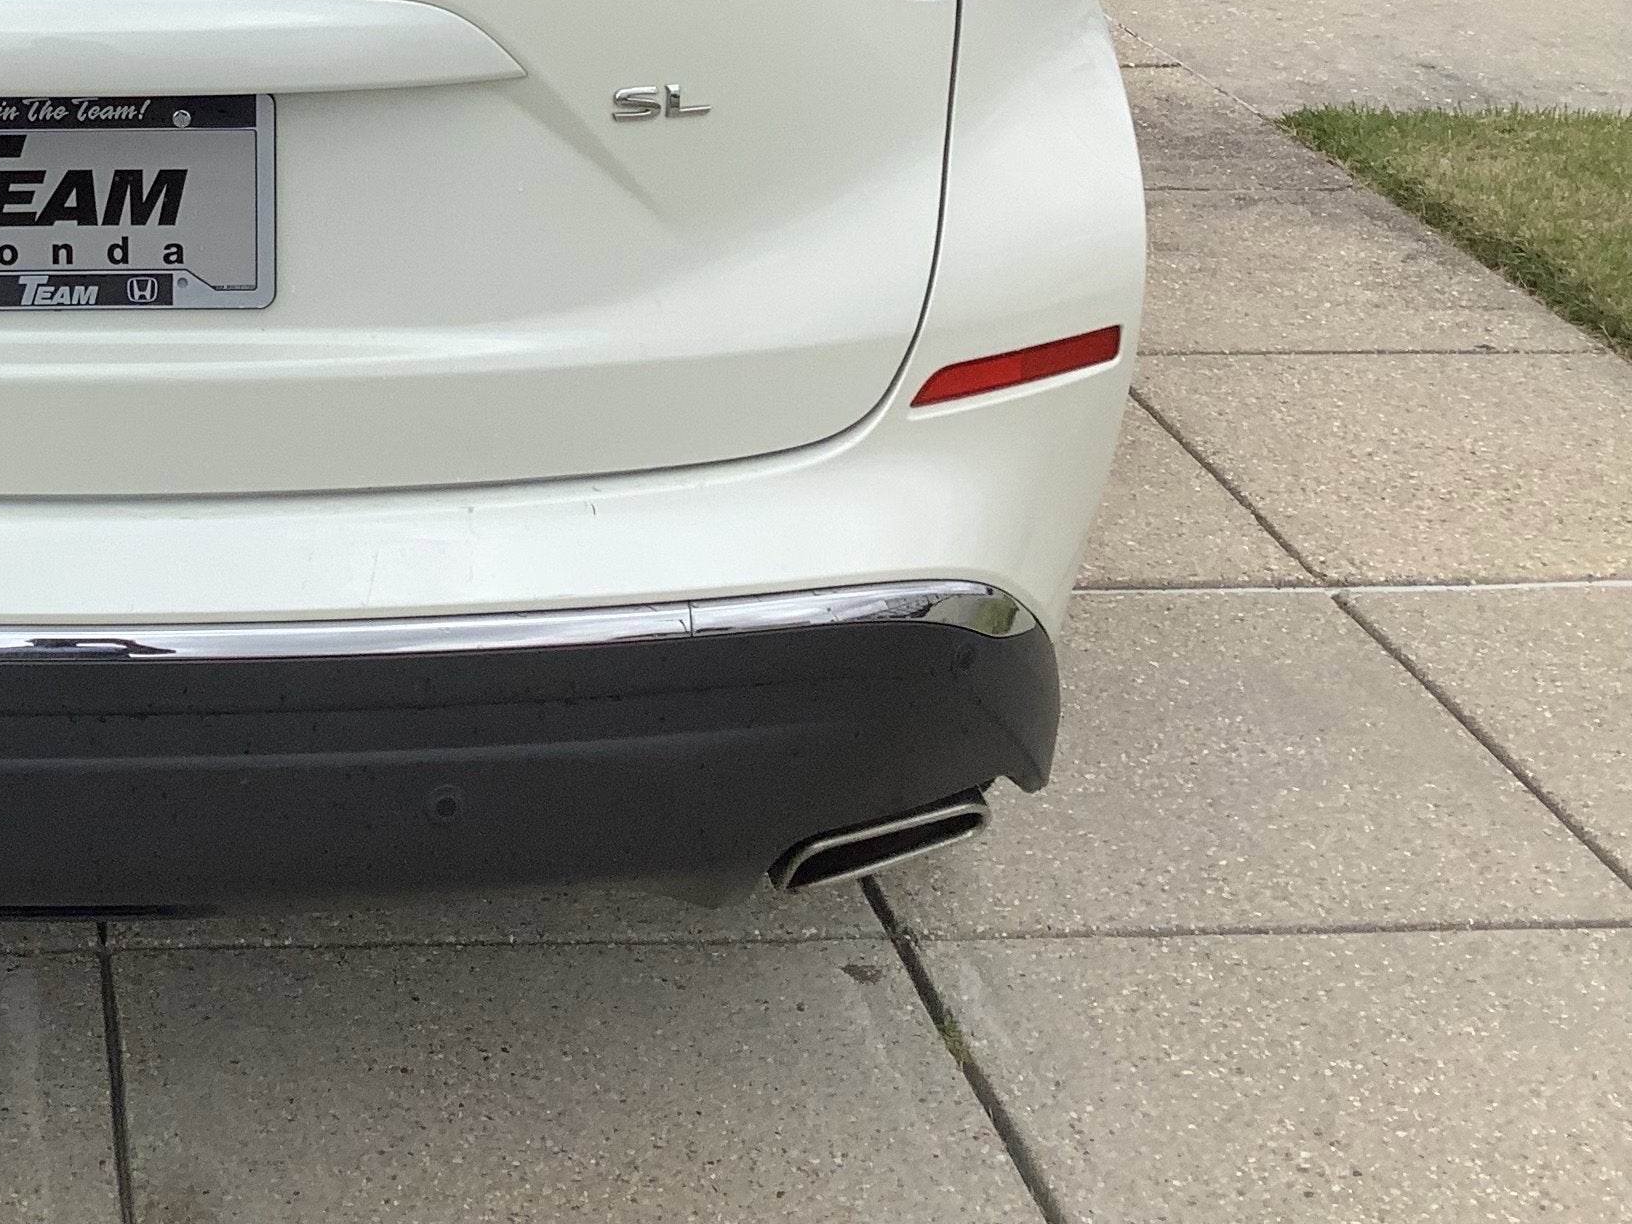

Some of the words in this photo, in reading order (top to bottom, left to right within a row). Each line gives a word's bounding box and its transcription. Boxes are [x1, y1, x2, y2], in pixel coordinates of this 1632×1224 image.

[21, 97, 70, 122] The
[71, 97, 152, 122] Team!
[612, 84, 712, 122] SL
[18, 275, 99, 306] TEAM
